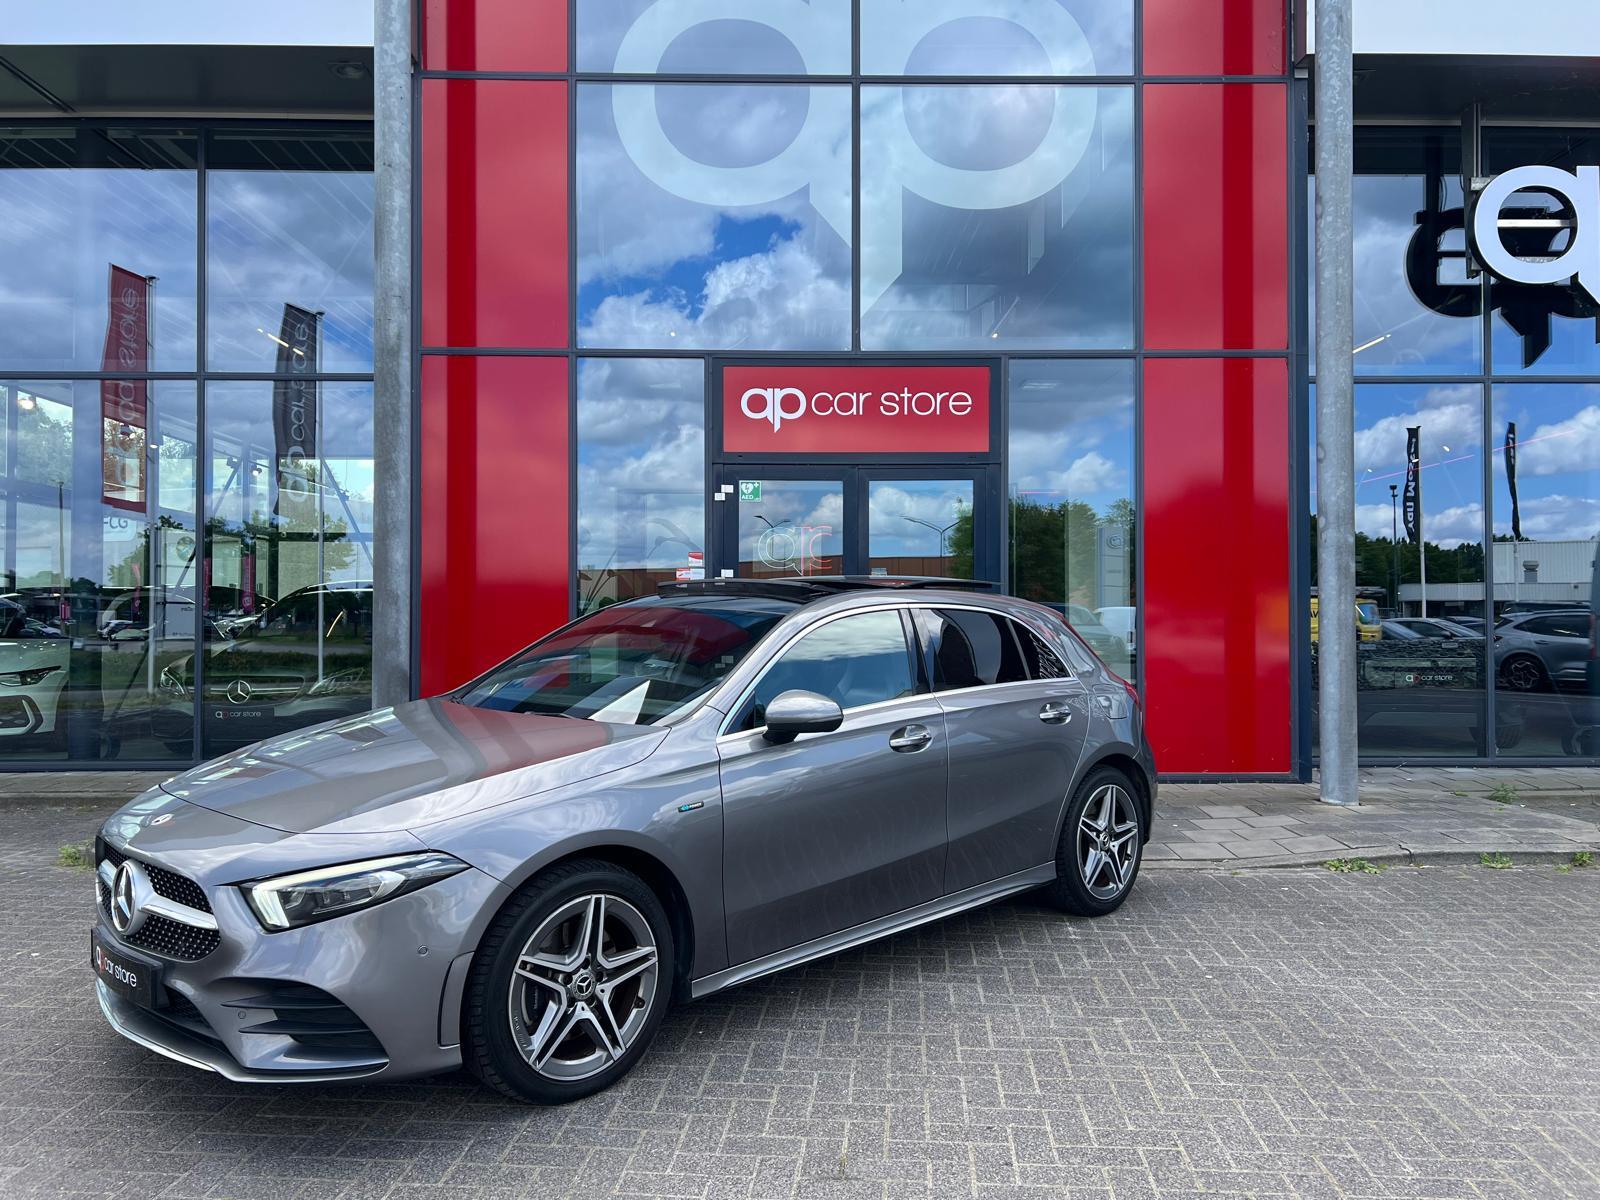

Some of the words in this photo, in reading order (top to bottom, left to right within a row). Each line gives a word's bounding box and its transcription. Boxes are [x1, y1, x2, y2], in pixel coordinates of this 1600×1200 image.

[740, 387, 807, 433] ap
[811, 391, 872, 416] car
[880, 387, 973, 416] store
[114, 964, 137, 988] store
